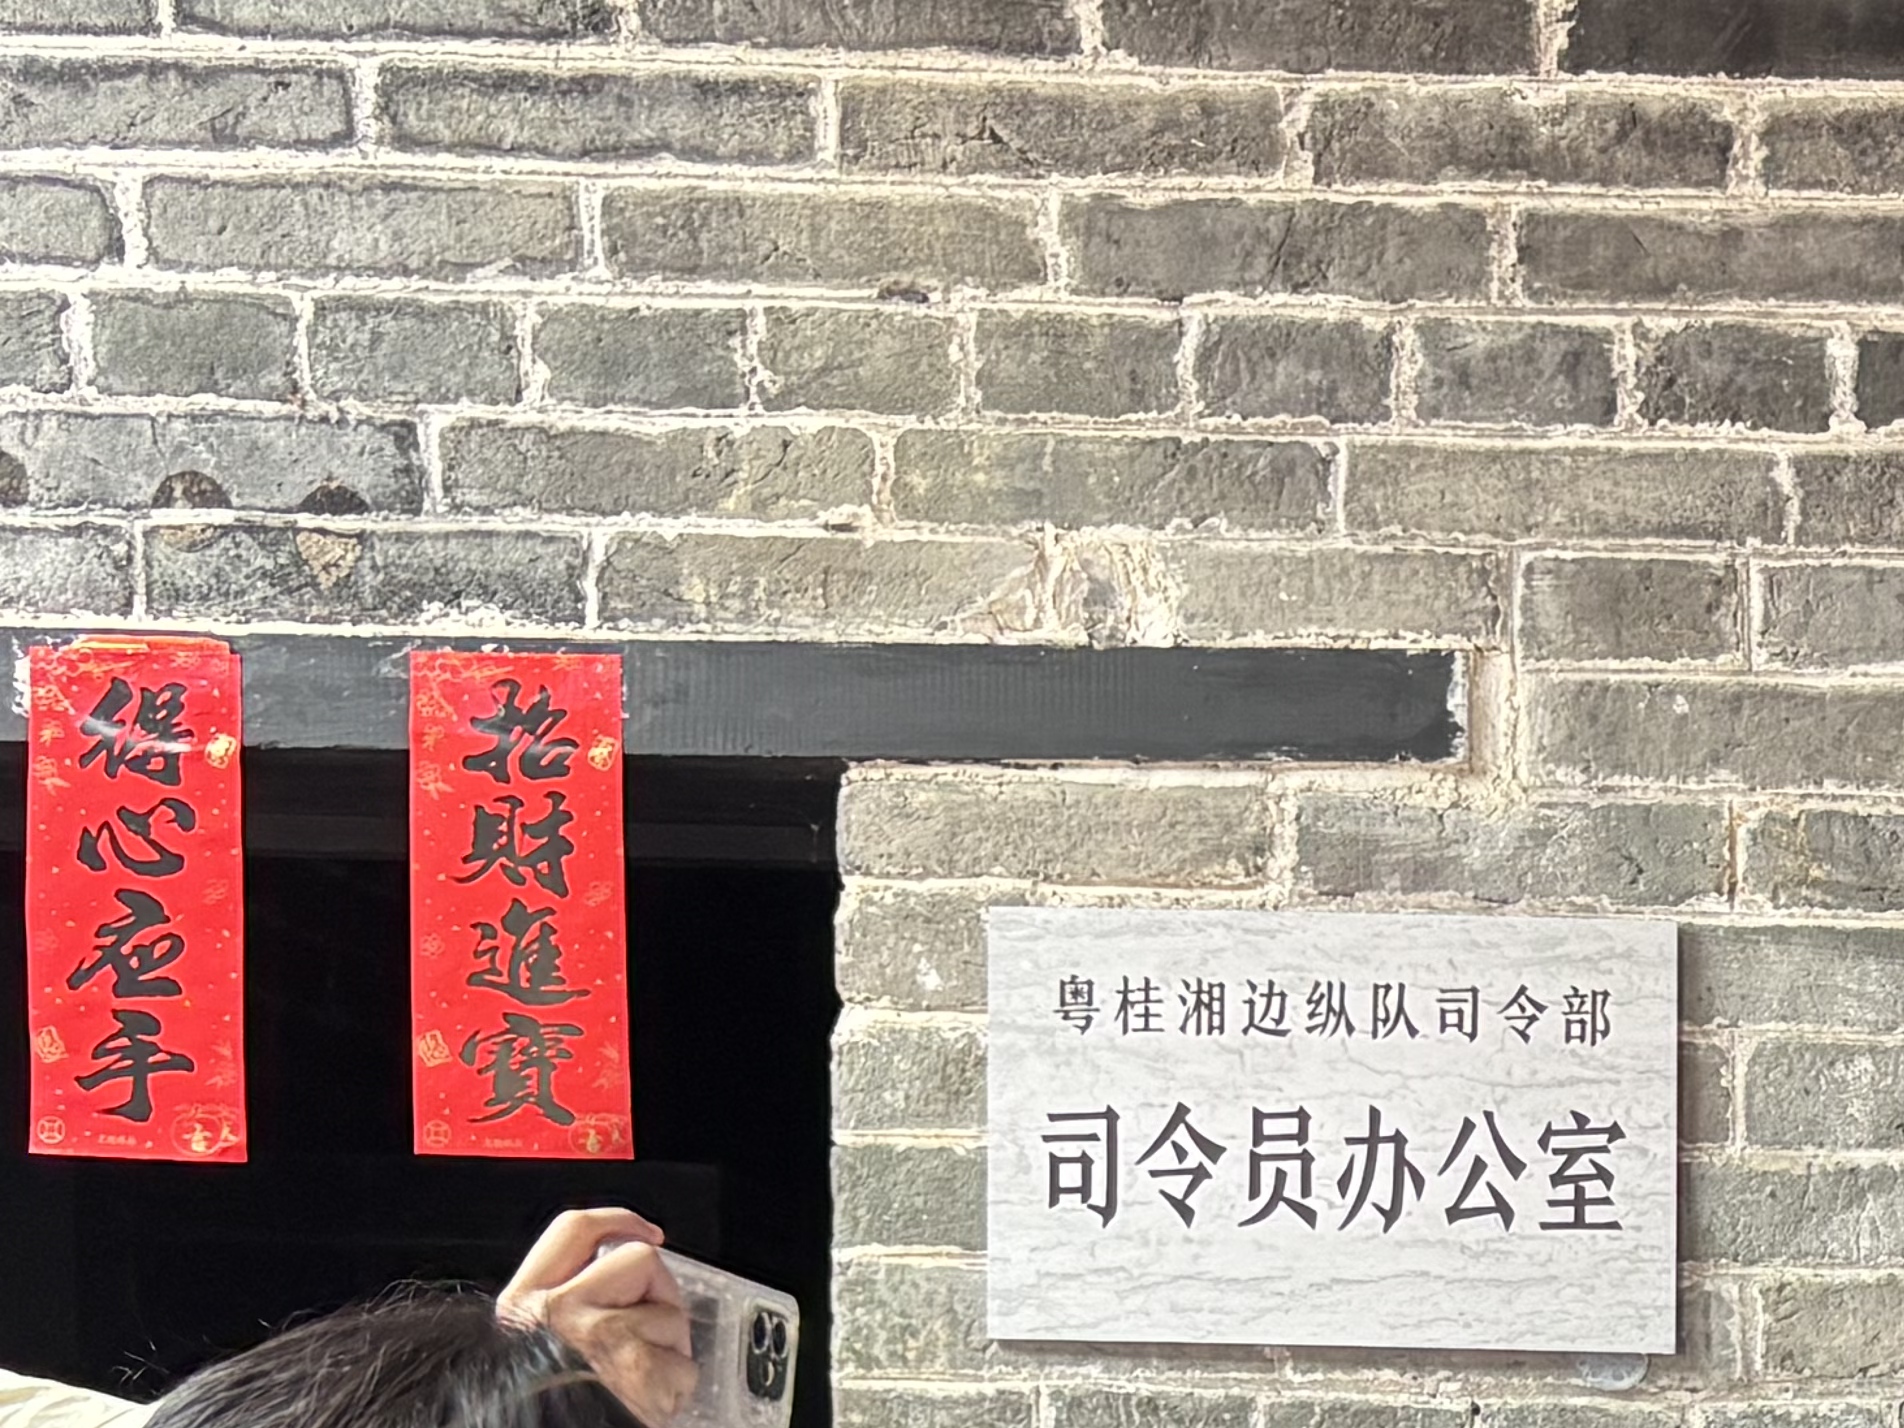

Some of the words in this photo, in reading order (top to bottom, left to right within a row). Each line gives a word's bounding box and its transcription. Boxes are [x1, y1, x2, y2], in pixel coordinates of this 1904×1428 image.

[1052, 975, 1614, 1045] 粤桂湘边纵队司令部
[1041, 1101, 1628, 1236] 司令员办公室
